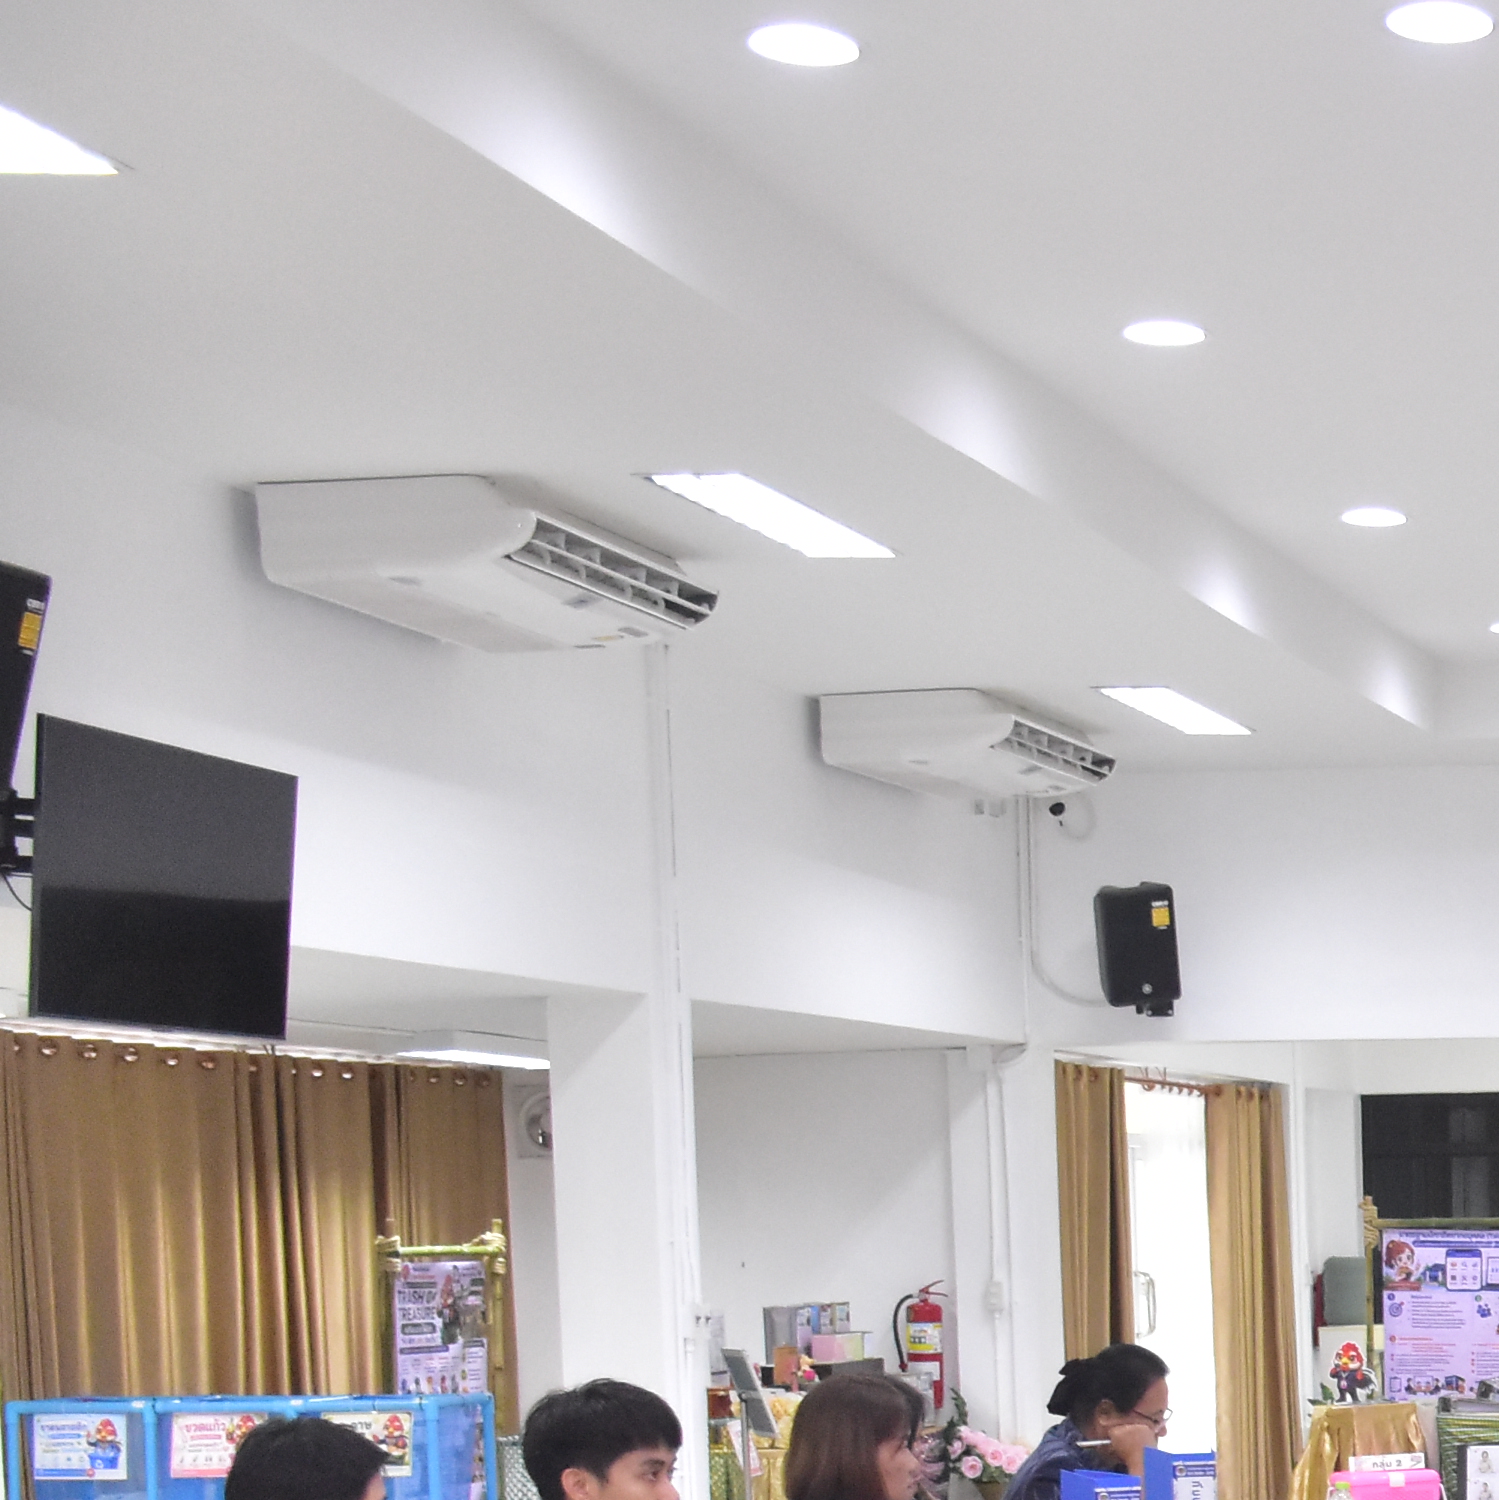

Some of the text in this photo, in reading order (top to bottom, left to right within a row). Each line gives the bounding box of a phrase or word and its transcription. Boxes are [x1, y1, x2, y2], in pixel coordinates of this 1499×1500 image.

[398, 1306, 436, 1321] TREASURE
[185, 1419, 226, 1433] ขวดแก้ว
[1396, 1459, 1403, 1467] 2
